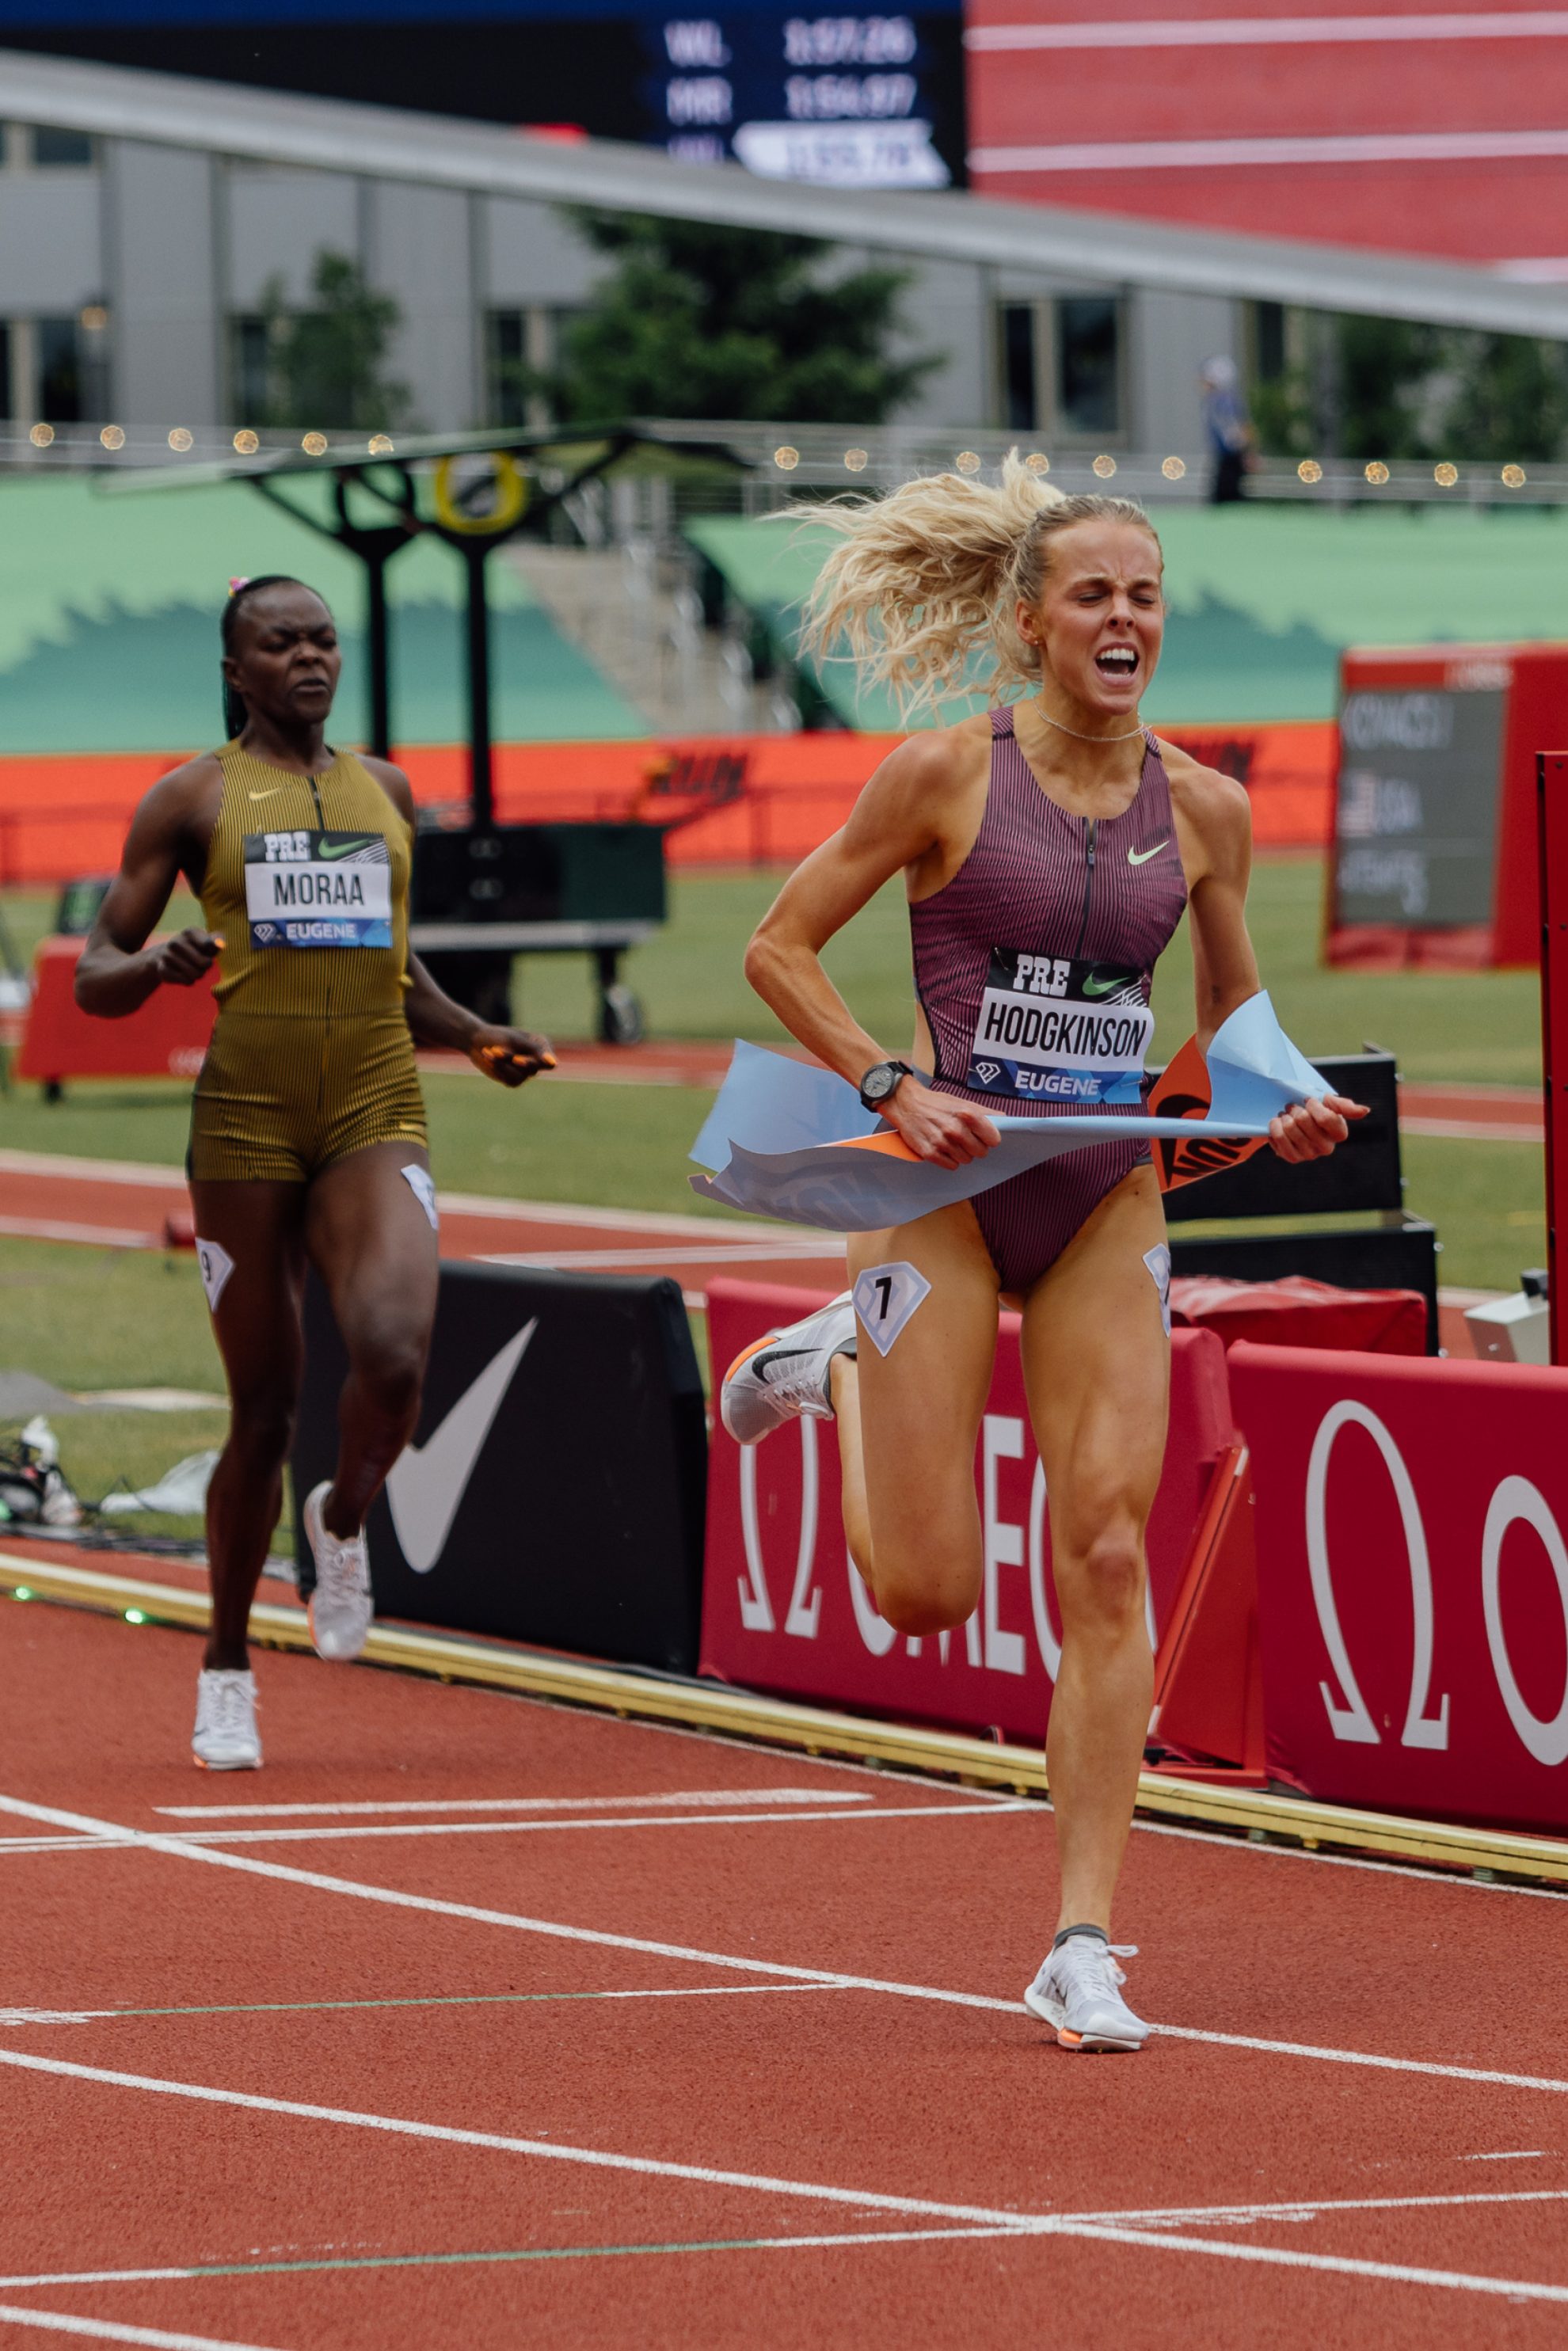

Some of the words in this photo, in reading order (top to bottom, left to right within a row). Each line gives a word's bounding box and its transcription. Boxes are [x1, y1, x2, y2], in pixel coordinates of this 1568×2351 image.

[264, 831, 311, 862] PRE
[273, 873, 364, 906] MORAA
[286, 923, 356, 939] EUGENE
[1013, 953, 1071, 997] PRE
[984, 1002, 1147, 1057] HODGKINSON
[1014, 1070, 1102, 1096] EUGENE
[200, 1250, 211, 1282] 9
